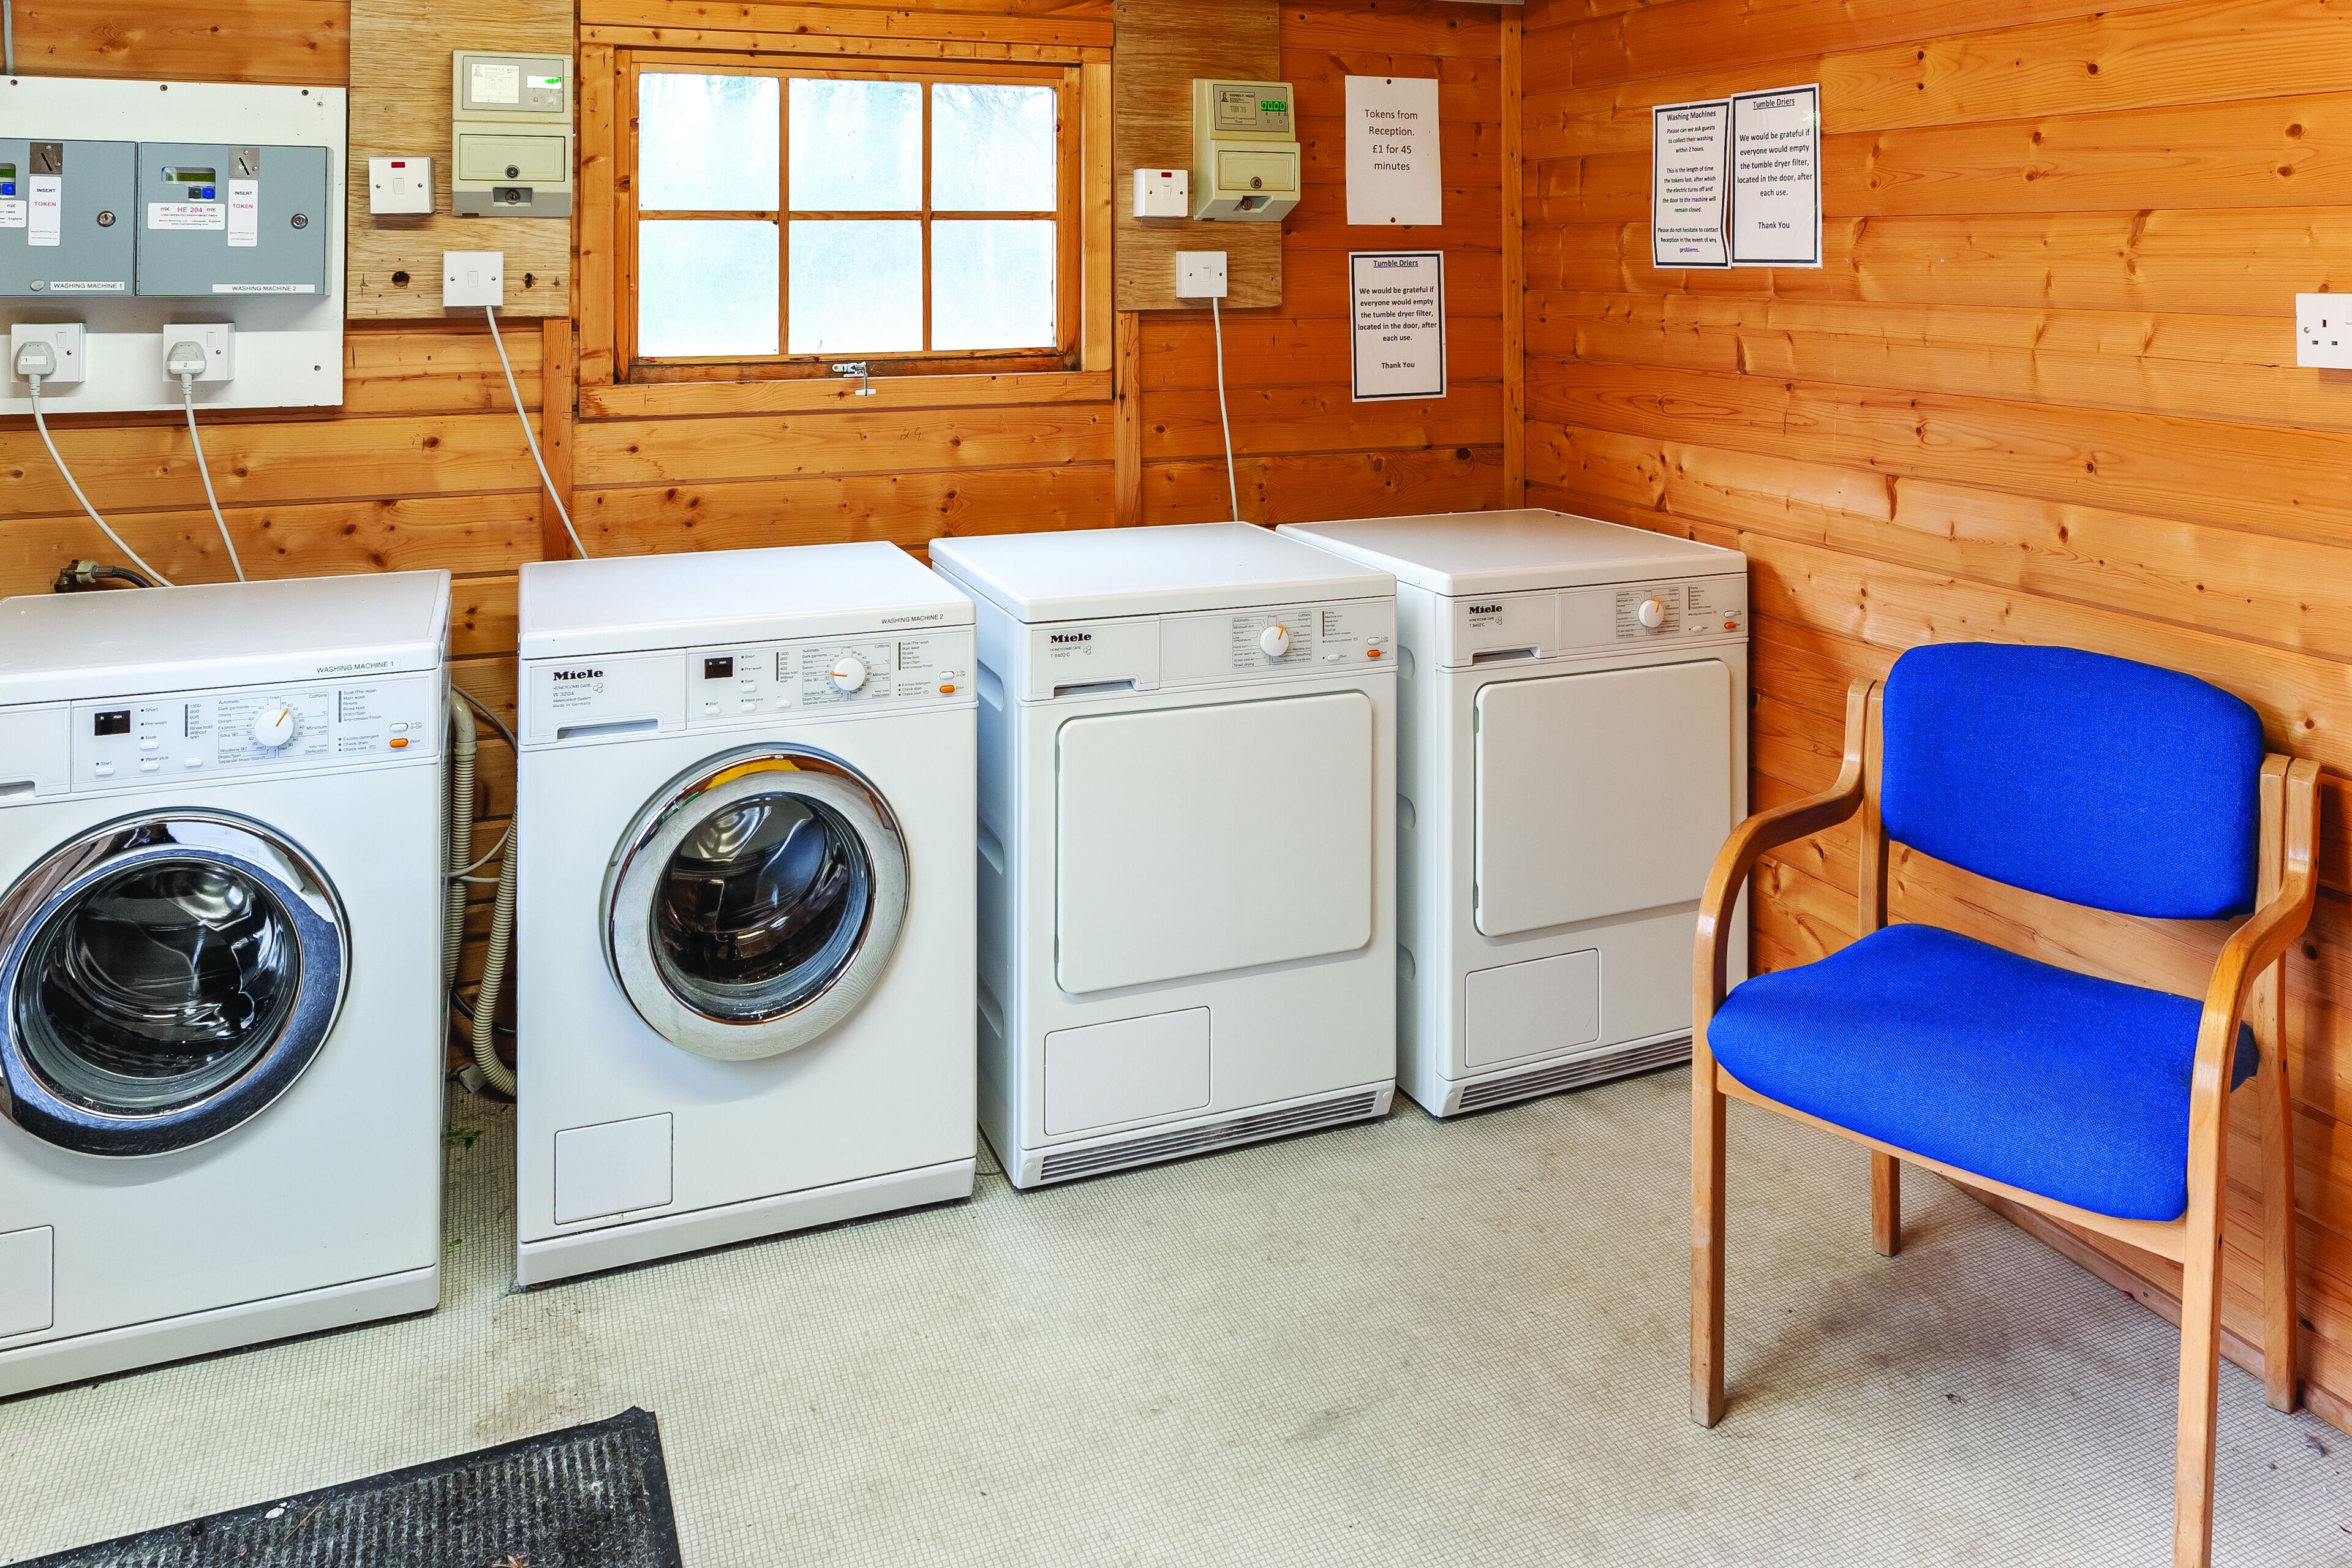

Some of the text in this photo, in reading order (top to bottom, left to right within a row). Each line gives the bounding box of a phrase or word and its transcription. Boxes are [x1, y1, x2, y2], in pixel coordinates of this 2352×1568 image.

[1262, 101, 1286, 110] 00.00
[1752, 97, 1795, 109] Tumble Driers
[1364, 109, 1418, 119] Tokens from
[1667, 110, 1716, 121] Washing Machines
[1369, 126, 1415, 137] Reception.
[1779, 129, 1803, 140] grateful
[1373, 145, 1383, 153] £1
[1386, 145, 1399, 154] for
[1769, 145, 1787, 153] would
[1789, 144, 1809, 153] empty
[1374, 161, 1410, 170] minutes
[1752, 160, 1773, 169] tumble
[1774, 160, 1790, 168] dryer
[1792, 158, 1809, 167] filter,
[1737, 175, 1759, 184] located
[1469, 605, 1502, 614] Miele
[1050, 633, 1091, 643] Miele
[317, 664, 352, 673] WASHING
[553, 669, 603, 680] Miele
